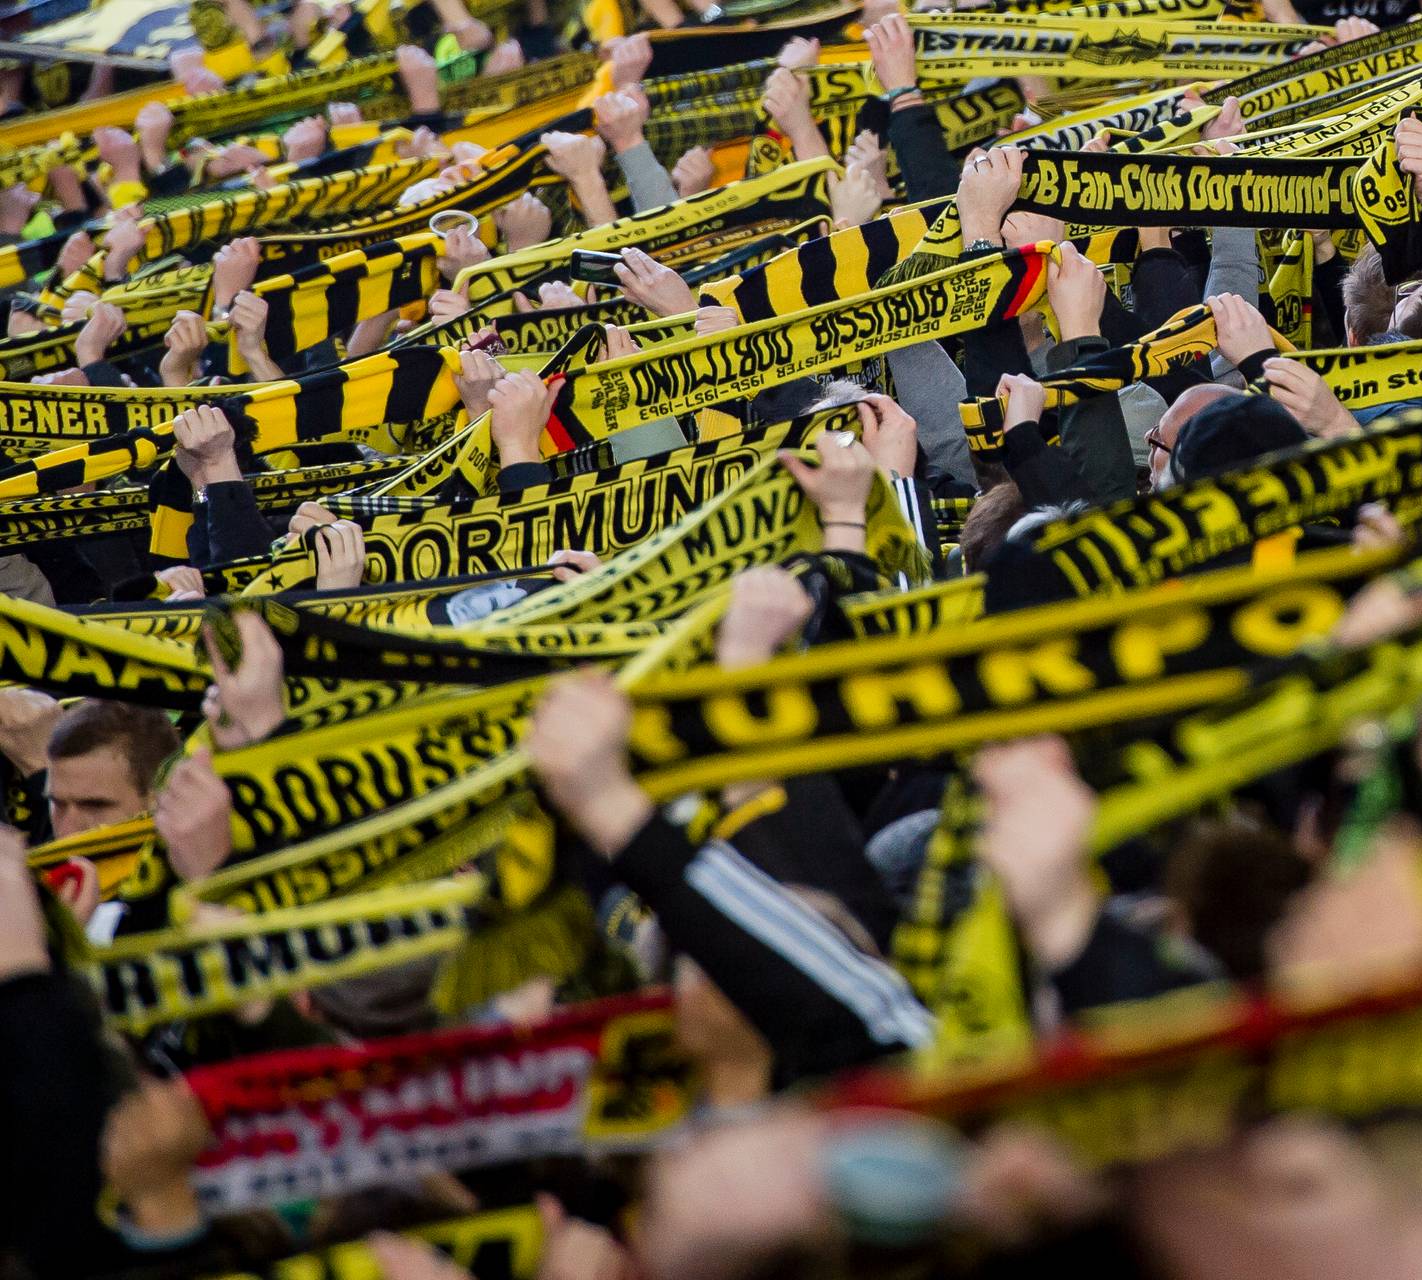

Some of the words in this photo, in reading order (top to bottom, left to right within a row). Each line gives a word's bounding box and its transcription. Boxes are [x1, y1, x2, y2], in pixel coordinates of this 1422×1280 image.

[1240, 76, 1318, 118] OU'LL
[1326, 45, 1422, 91] NEVER
[1303, 120, 1351, 145] UND
[1356, 90, 1409, 121] TREU
[1061, 160, 1185, 212] Fan-Club
[814, 279, 949, 351] BORUSSIA
[973, 277, 992, 323] SIEGER
[854, 319, 940, 353] DEUTSCHER
[633, 325, 794, 408] DORTMUND
[776, 348, 842, 378] MEISTER
[0, 439, 50, 450] OLZ
[303, 464, 351, 481] SUPER
[363, 447, 761, 586] DORTMUND
